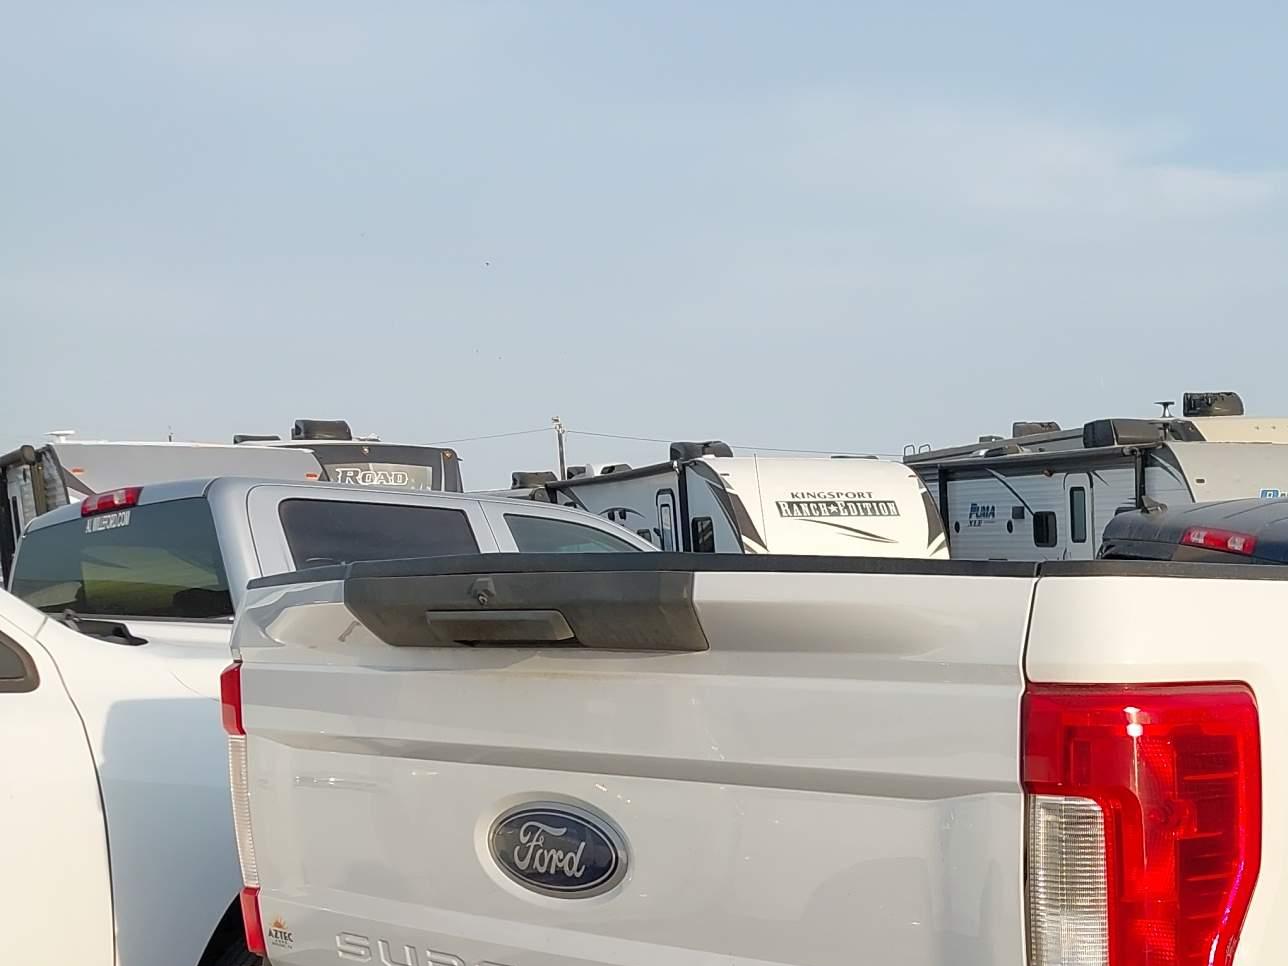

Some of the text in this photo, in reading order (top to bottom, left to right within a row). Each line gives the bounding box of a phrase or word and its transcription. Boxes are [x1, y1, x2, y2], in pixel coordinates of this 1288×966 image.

[336, 468, 408, 485] ROAD
[790, 491, 873, 499] KINGSPORT
[777, 501, 898, 517] RANCH EDITION
[969, 503, 996, 519] PUMA
[514, 821, 586, 878] Ford
[268, 928, 294, 943] AZTEC
